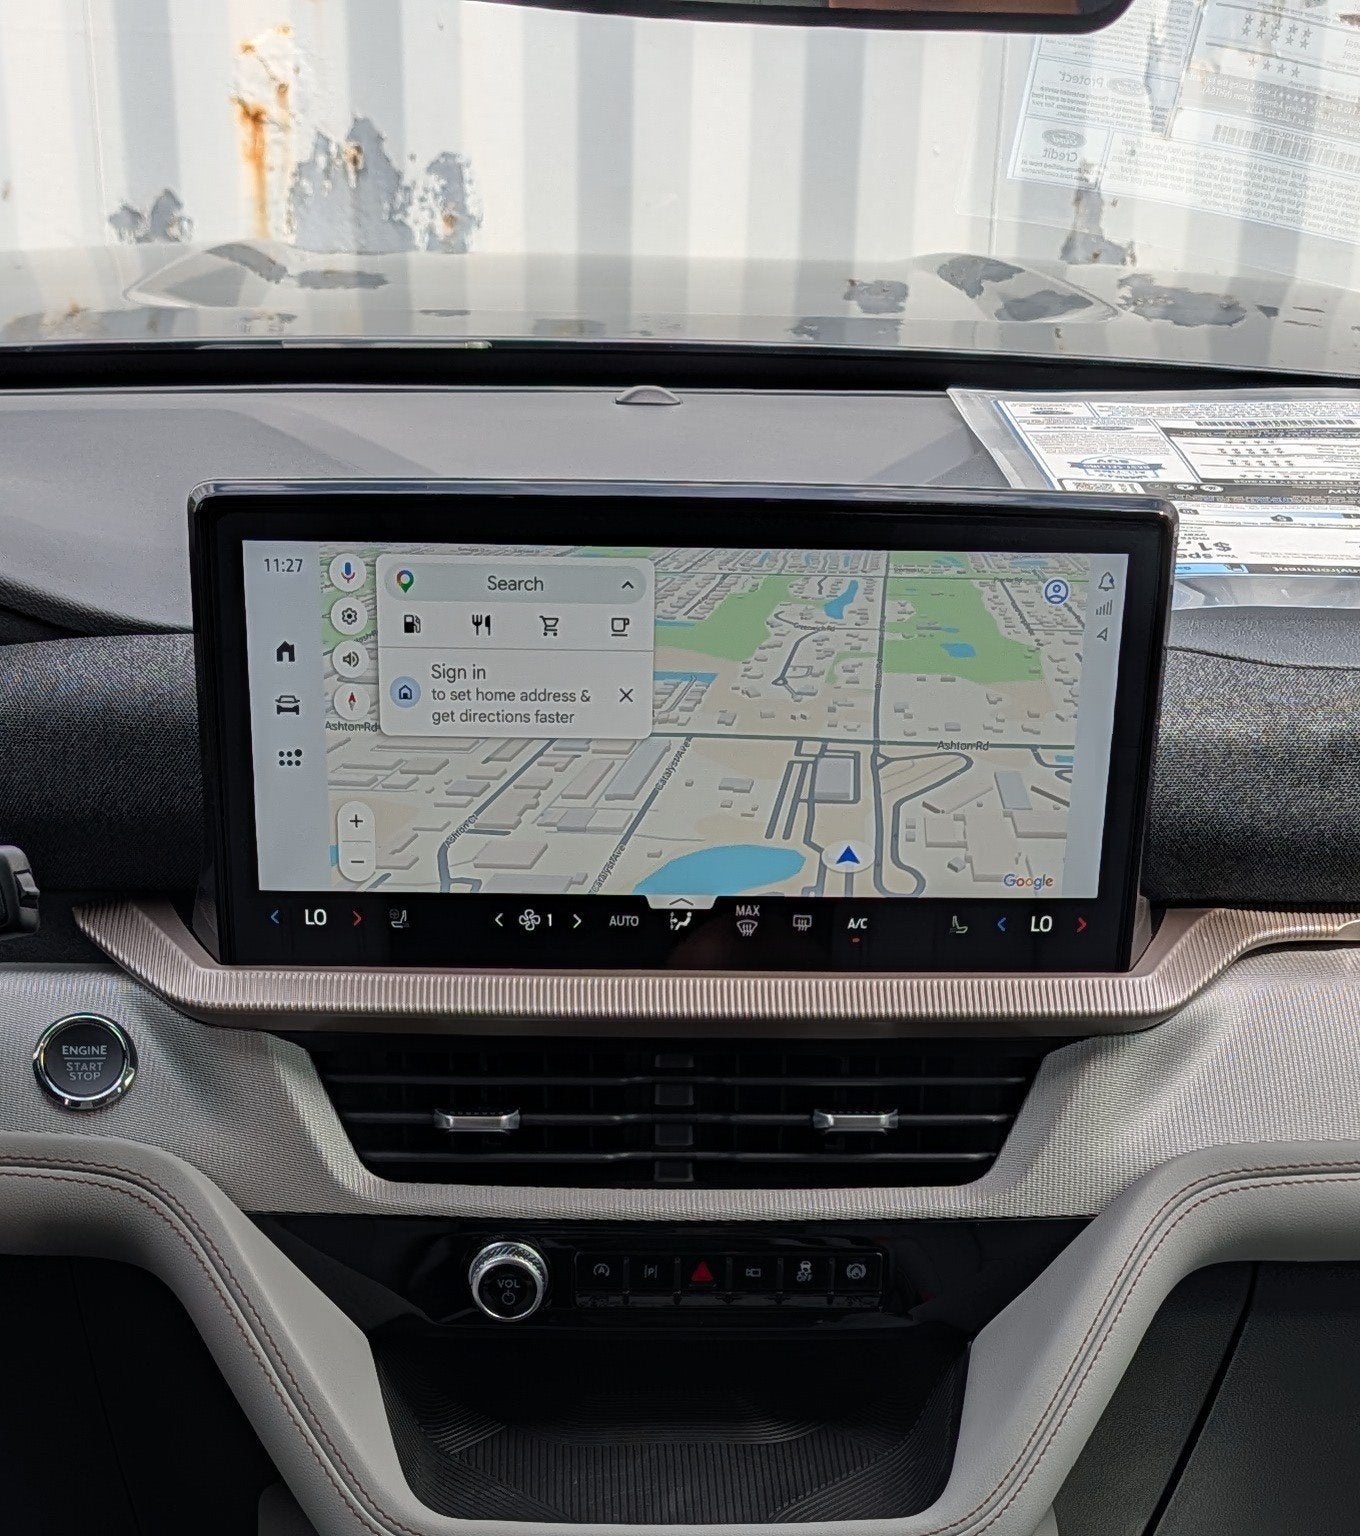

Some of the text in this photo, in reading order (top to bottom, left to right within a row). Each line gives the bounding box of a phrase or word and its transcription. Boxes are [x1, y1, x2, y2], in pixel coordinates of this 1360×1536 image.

[263, 557, 304, 574] 11:27
[486, 575, 545, 592] Search
[430, 663, 487, 684] Sign in
[430, 687, 592, 703] to set home address &
[431, 709, 575, 726] get directions faster
[936, 738, 990, 753] Ashton Rd
[654, 752, 680, 792] Catalyst
[443, 822, 470, 849] Ashton
[590, 854, 617, 895] Catalyst
[1002, 872, 1054, 891] Google
[304, 908, 328, 927] LO
[735, 904, 761, 917] MAX
[546, 913, 553, 927] 1
[608, 914, 640, 928] AUTO
[847, 916, 869, 931] A/C
[1030, 915, 1053, 933] LO
[61, 1044, 108, 1055] ENGINE
[66, 1061, 104, 1071] START
[69, 1071, 101, 1081] STOP
[497, 1278, 521, 1289] VOL
